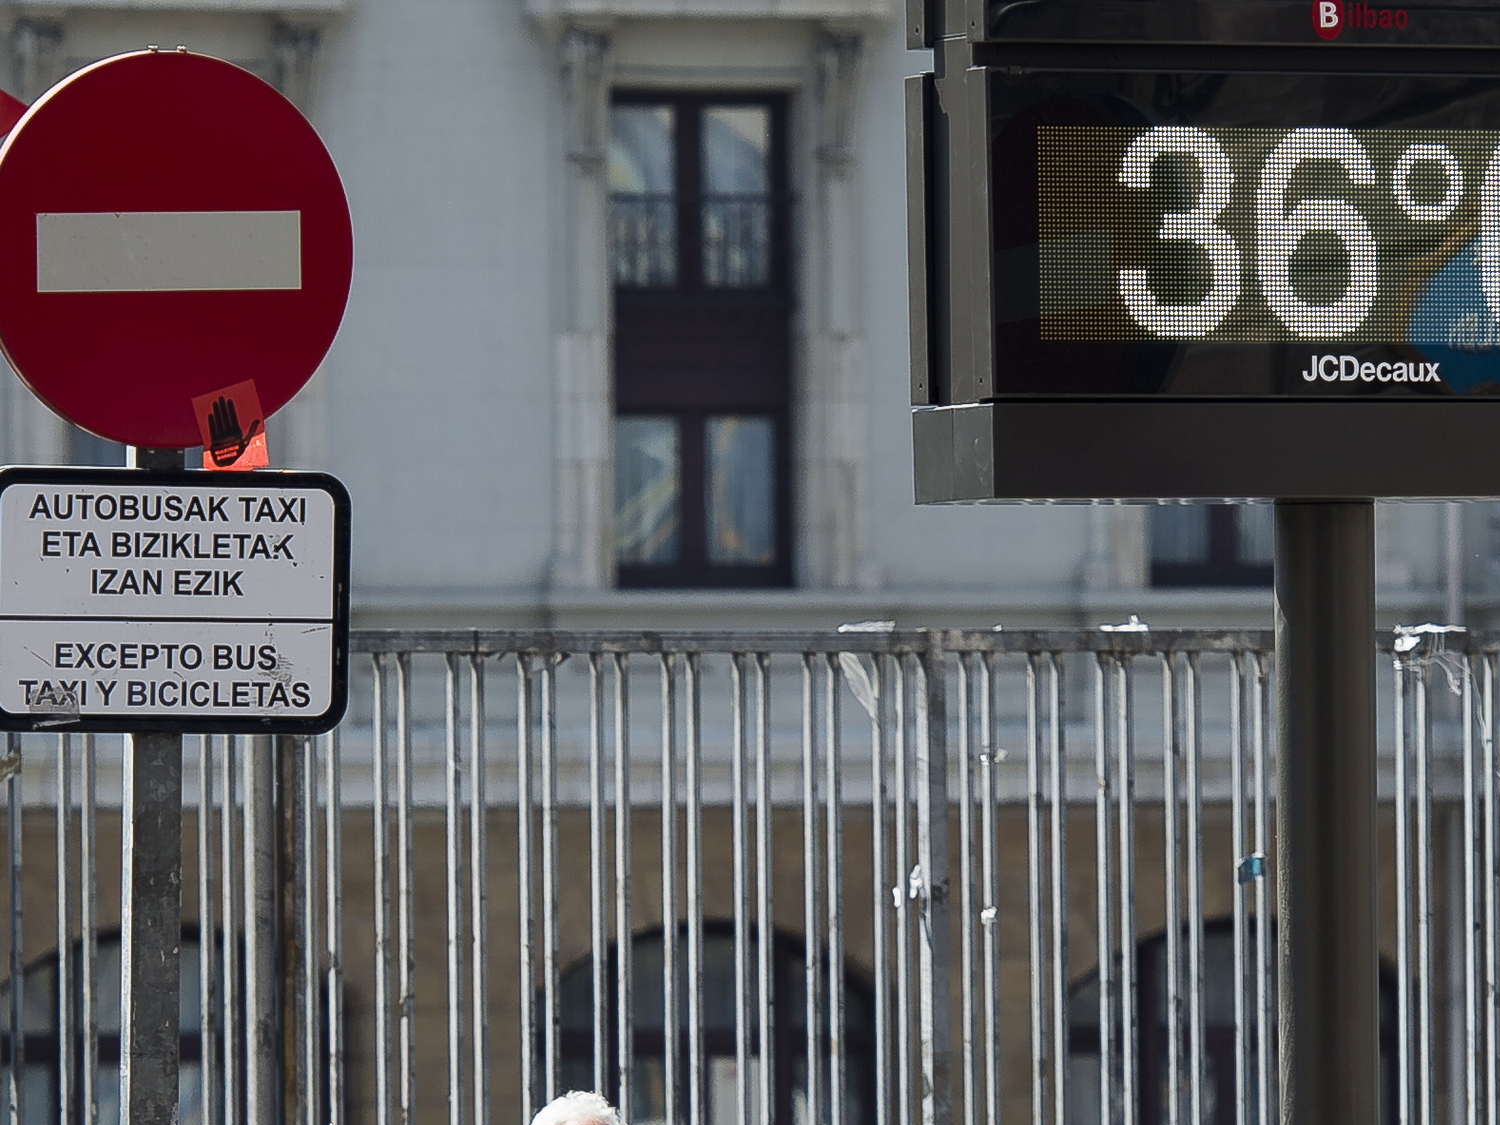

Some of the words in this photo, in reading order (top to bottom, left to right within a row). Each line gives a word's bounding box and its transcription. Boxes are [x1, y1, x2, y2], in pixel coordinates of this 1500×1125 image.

[1319, 1, 1409, 28] Bilbao
[1302, 354, 1441, 382] JCDecaux
[29, 494, 229, 522] AUTOBUSAK
[238, 497, 306, 523] TAXI
[41, 531, 102, 557] ETA
[111, 532, 295, 560] BIZIKLETAK
[91, 569, 162, 595] IZAN
[174, 570, 244, 596] EZIK
[55, 643, 202, 670] EXCEPTO
[213, 645, 278, 671] BUS
[19, 680, 87, 706] TAXI
[96, 680, 118, 706] Y
[127, 681, 311, 708] BICICLETAS
